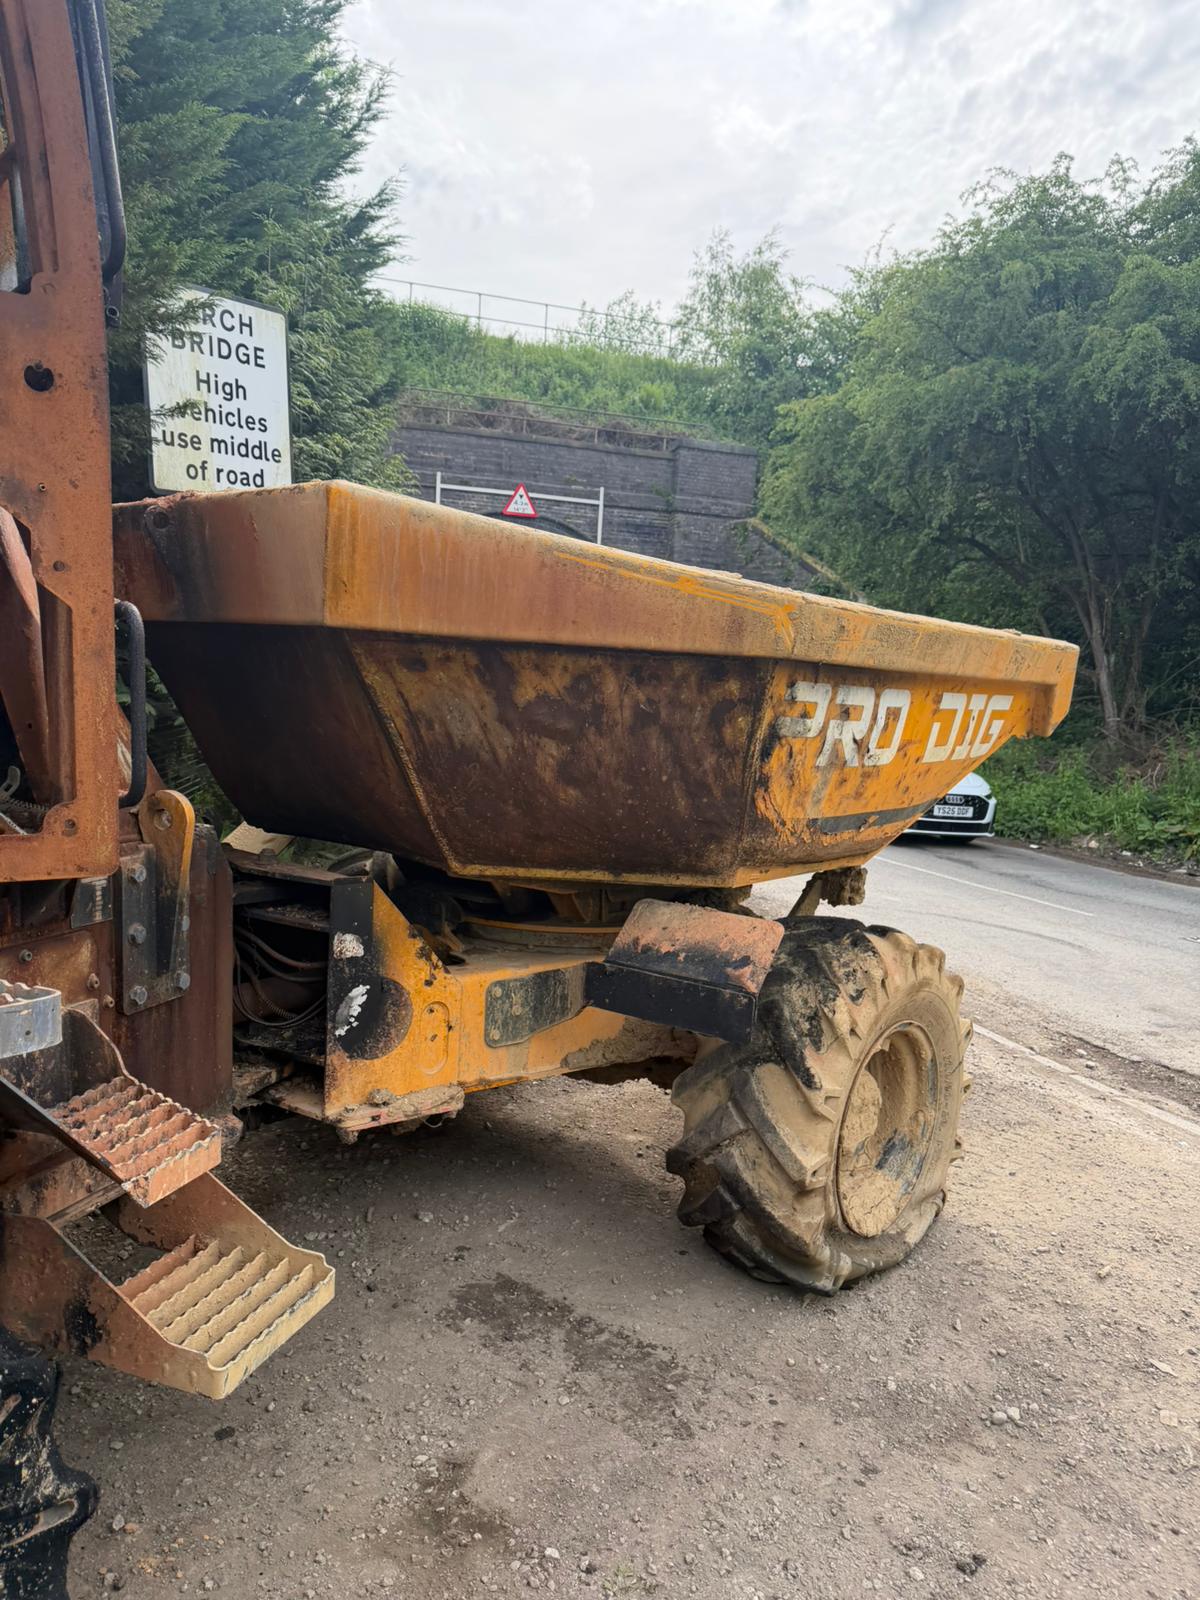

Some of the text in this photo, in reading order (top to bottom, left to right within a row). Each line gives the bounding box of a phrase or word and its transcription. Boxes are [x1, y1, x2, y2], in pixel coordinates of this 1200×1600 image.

[198, 306, 253, 337] RCH
[170, 329, 266, 369] BRIDGE
[195, 370, 247, 402] High
[162, 429, 282, 463] use middle
[186, 460, 265, 488] of road
[775, 681, 1014, 768] PRO DIG
